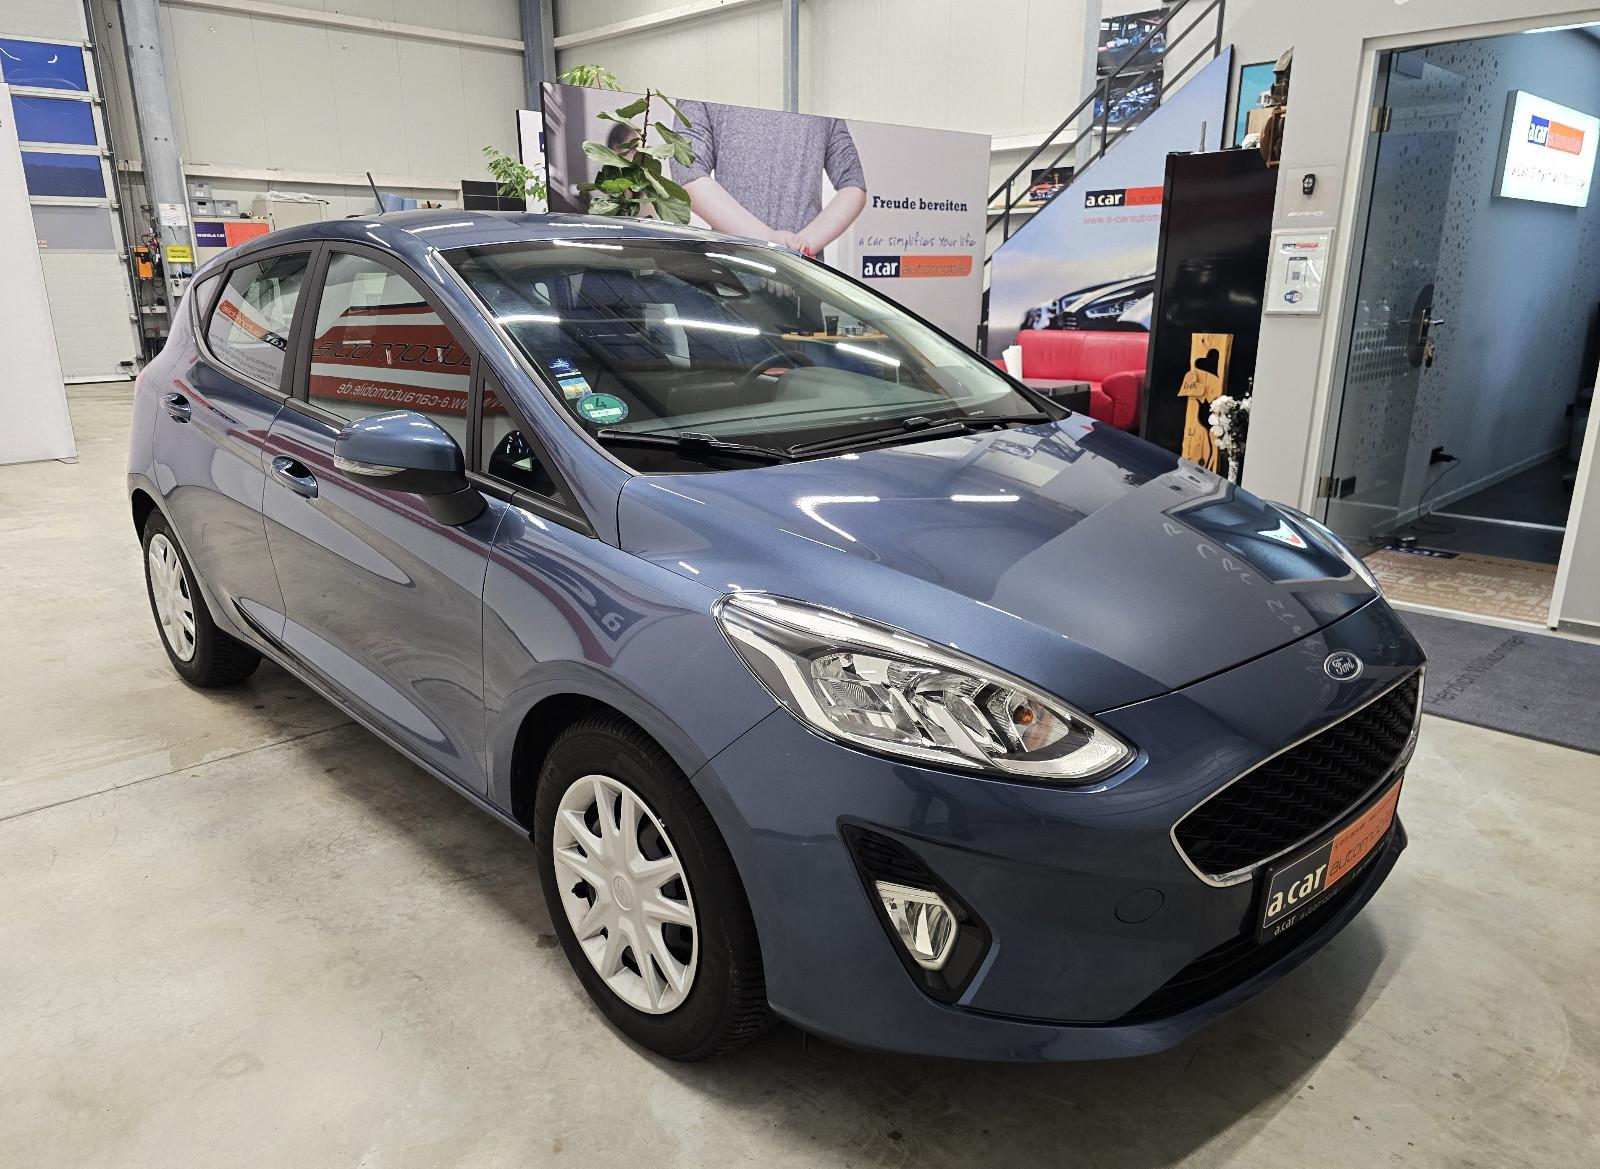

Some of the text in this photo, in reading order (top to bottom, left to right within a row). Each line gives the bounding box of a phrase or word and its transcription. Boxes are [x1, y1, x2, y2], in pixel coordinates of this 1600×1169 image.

[872, 195, 968, 212] Freude bereiten
[1331, 656, 1355, 676] Ford
[1267, 863, 1327, 917] a.car
